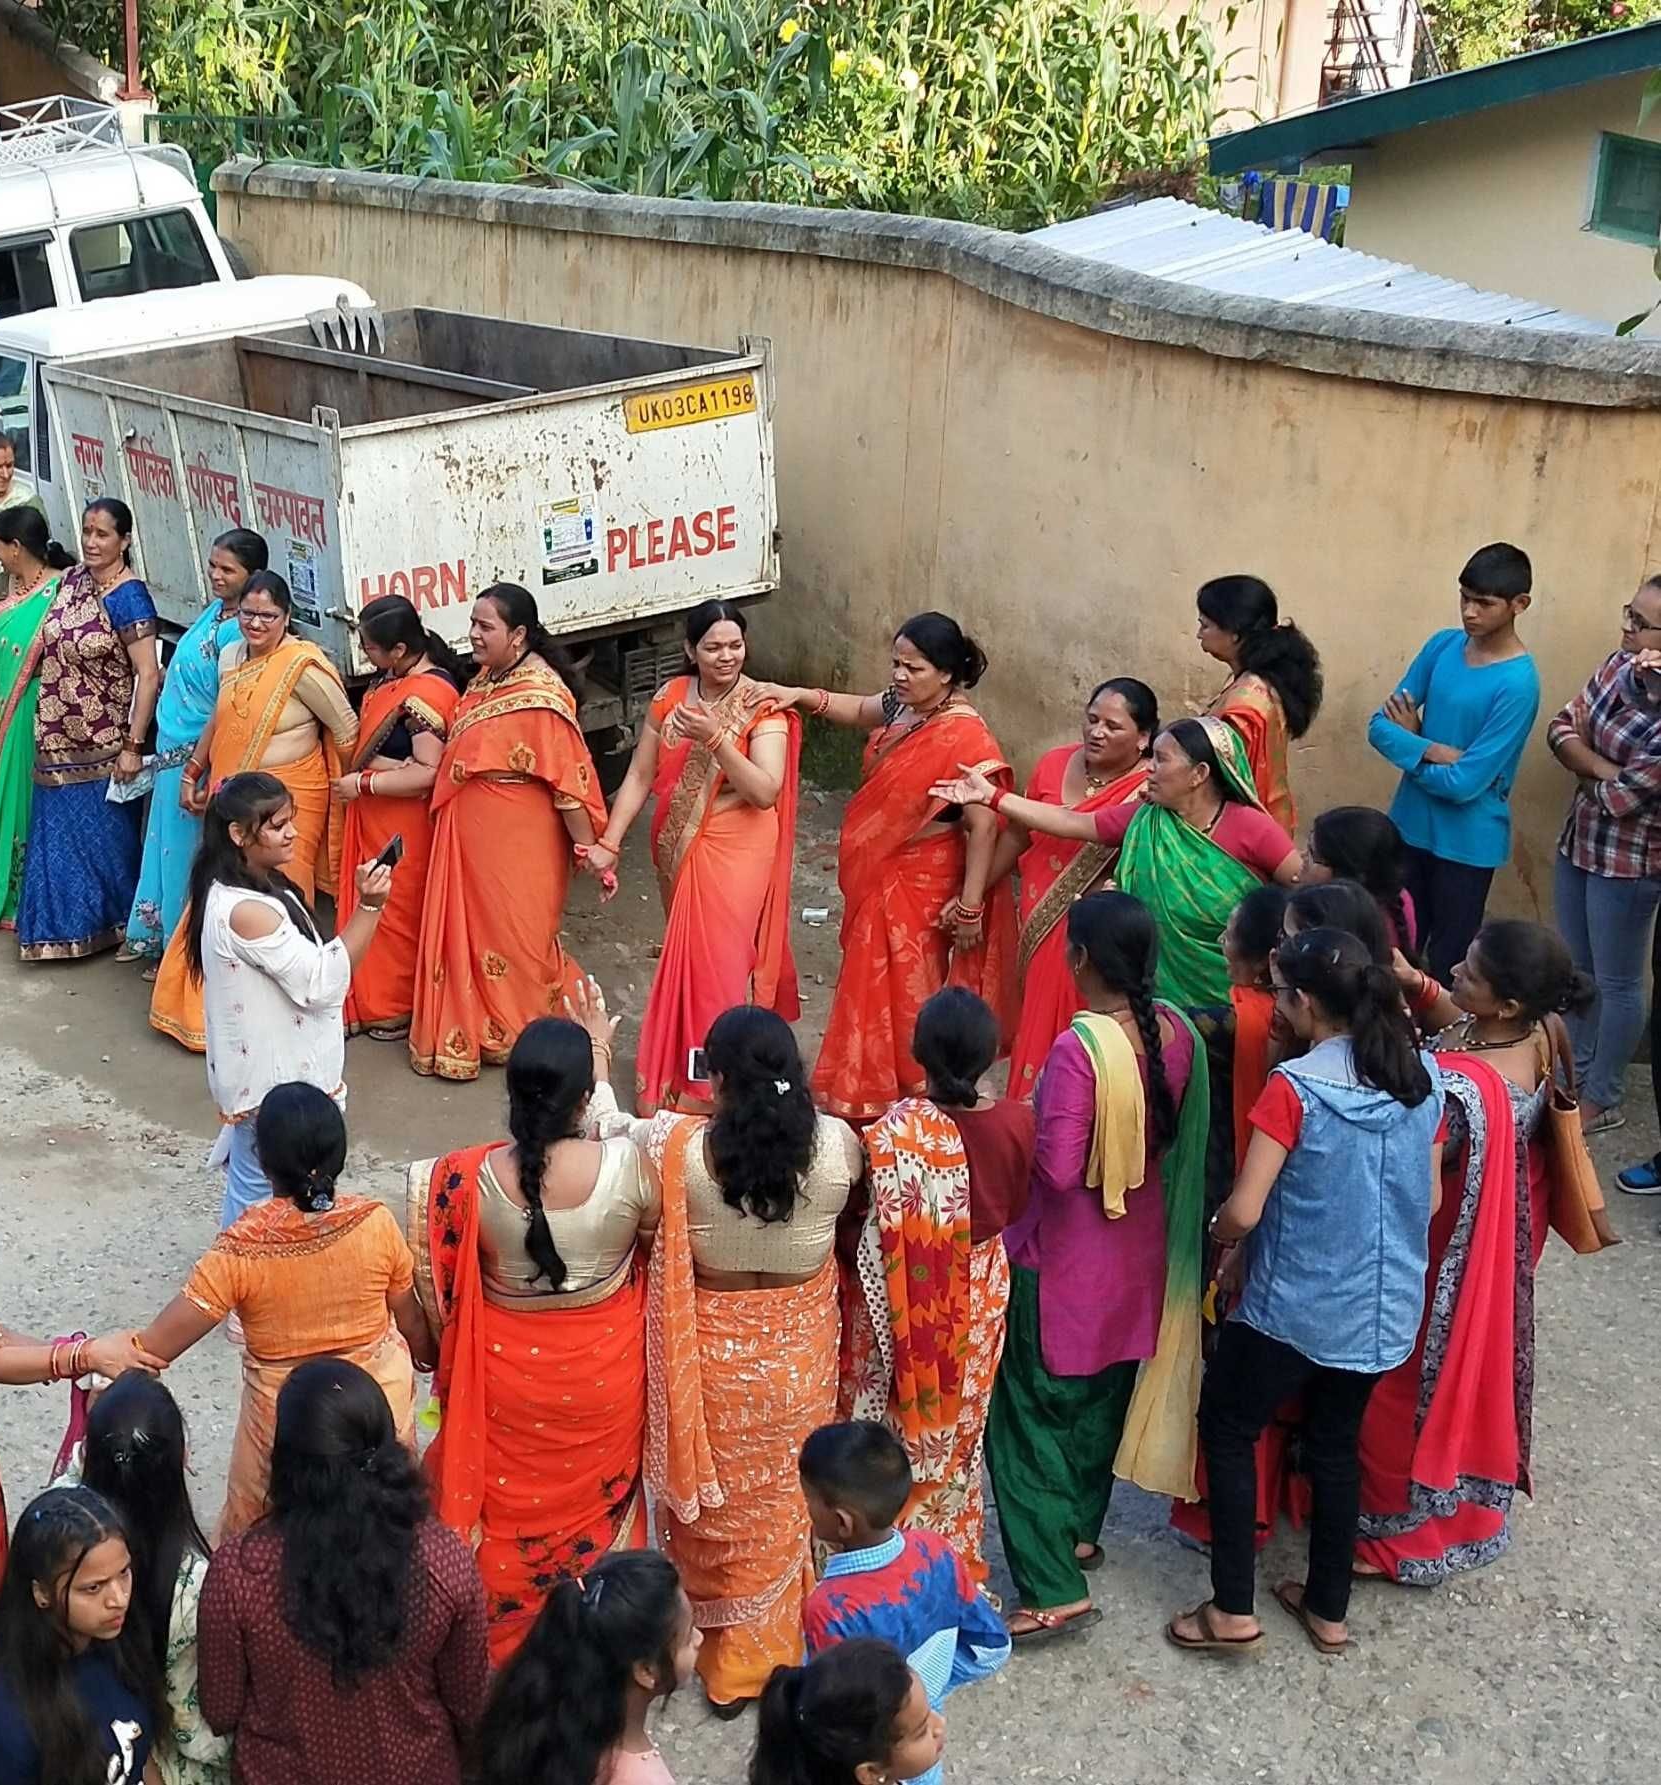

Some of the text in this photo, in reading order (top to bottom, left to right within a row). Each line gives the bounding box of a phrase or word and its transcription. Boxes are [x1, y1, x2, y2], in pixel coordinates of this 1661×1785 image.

[640, 384, 753, 424] UK03CA1198
[71, 432, 107, 487] नगर
[125, 436, 178, 501] पालिका
[253, 482, 327, 553] चम्पावत
[360, 559, 468, 612] HORN
[607, 505, 737, 573] PLEASE
